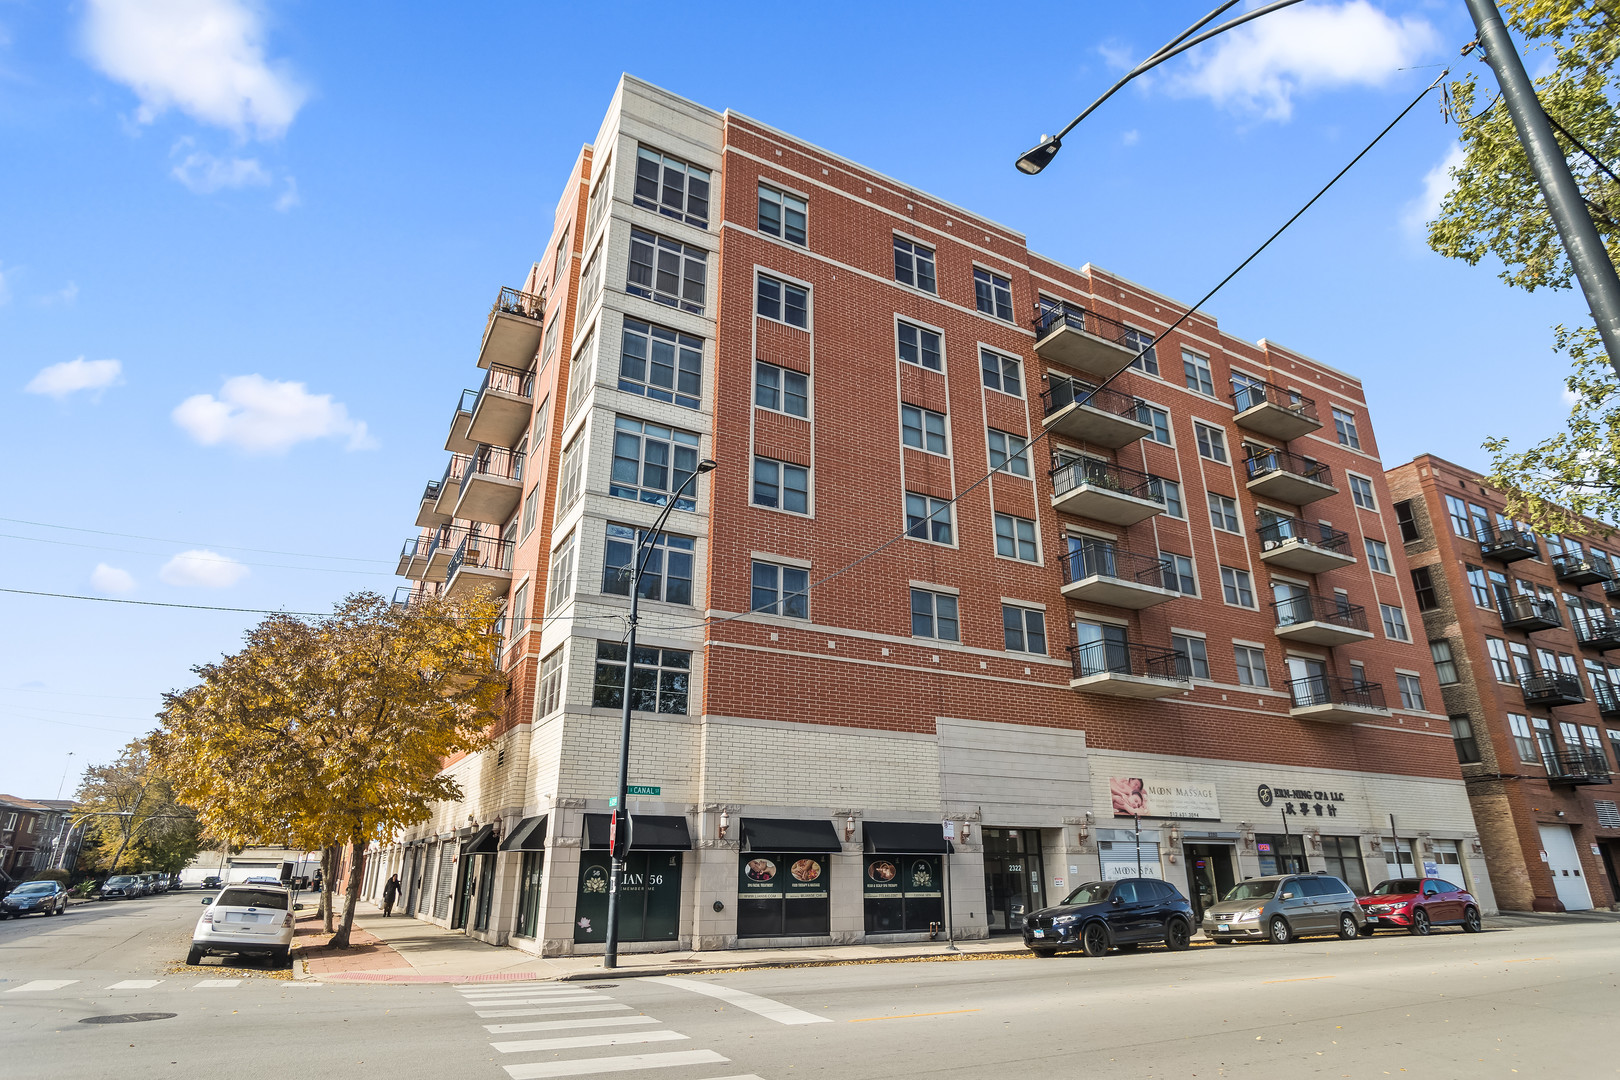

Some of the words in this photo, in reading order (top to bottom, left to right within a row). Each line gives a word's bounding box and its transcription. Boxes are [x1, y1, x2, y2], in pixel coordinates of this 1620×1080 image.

[1148, 786, 1172, 795] MOON
[1176, 788, 1212, 798] MASSAGE
[1274, 788, 1312, 800] ERN-NING
[1314, 791, 1329, 800] CPA
[1330, 792, 1344, 801] LLC
[621, 874, 643, 884] IAN
[649, 875, 663, 885] 56
